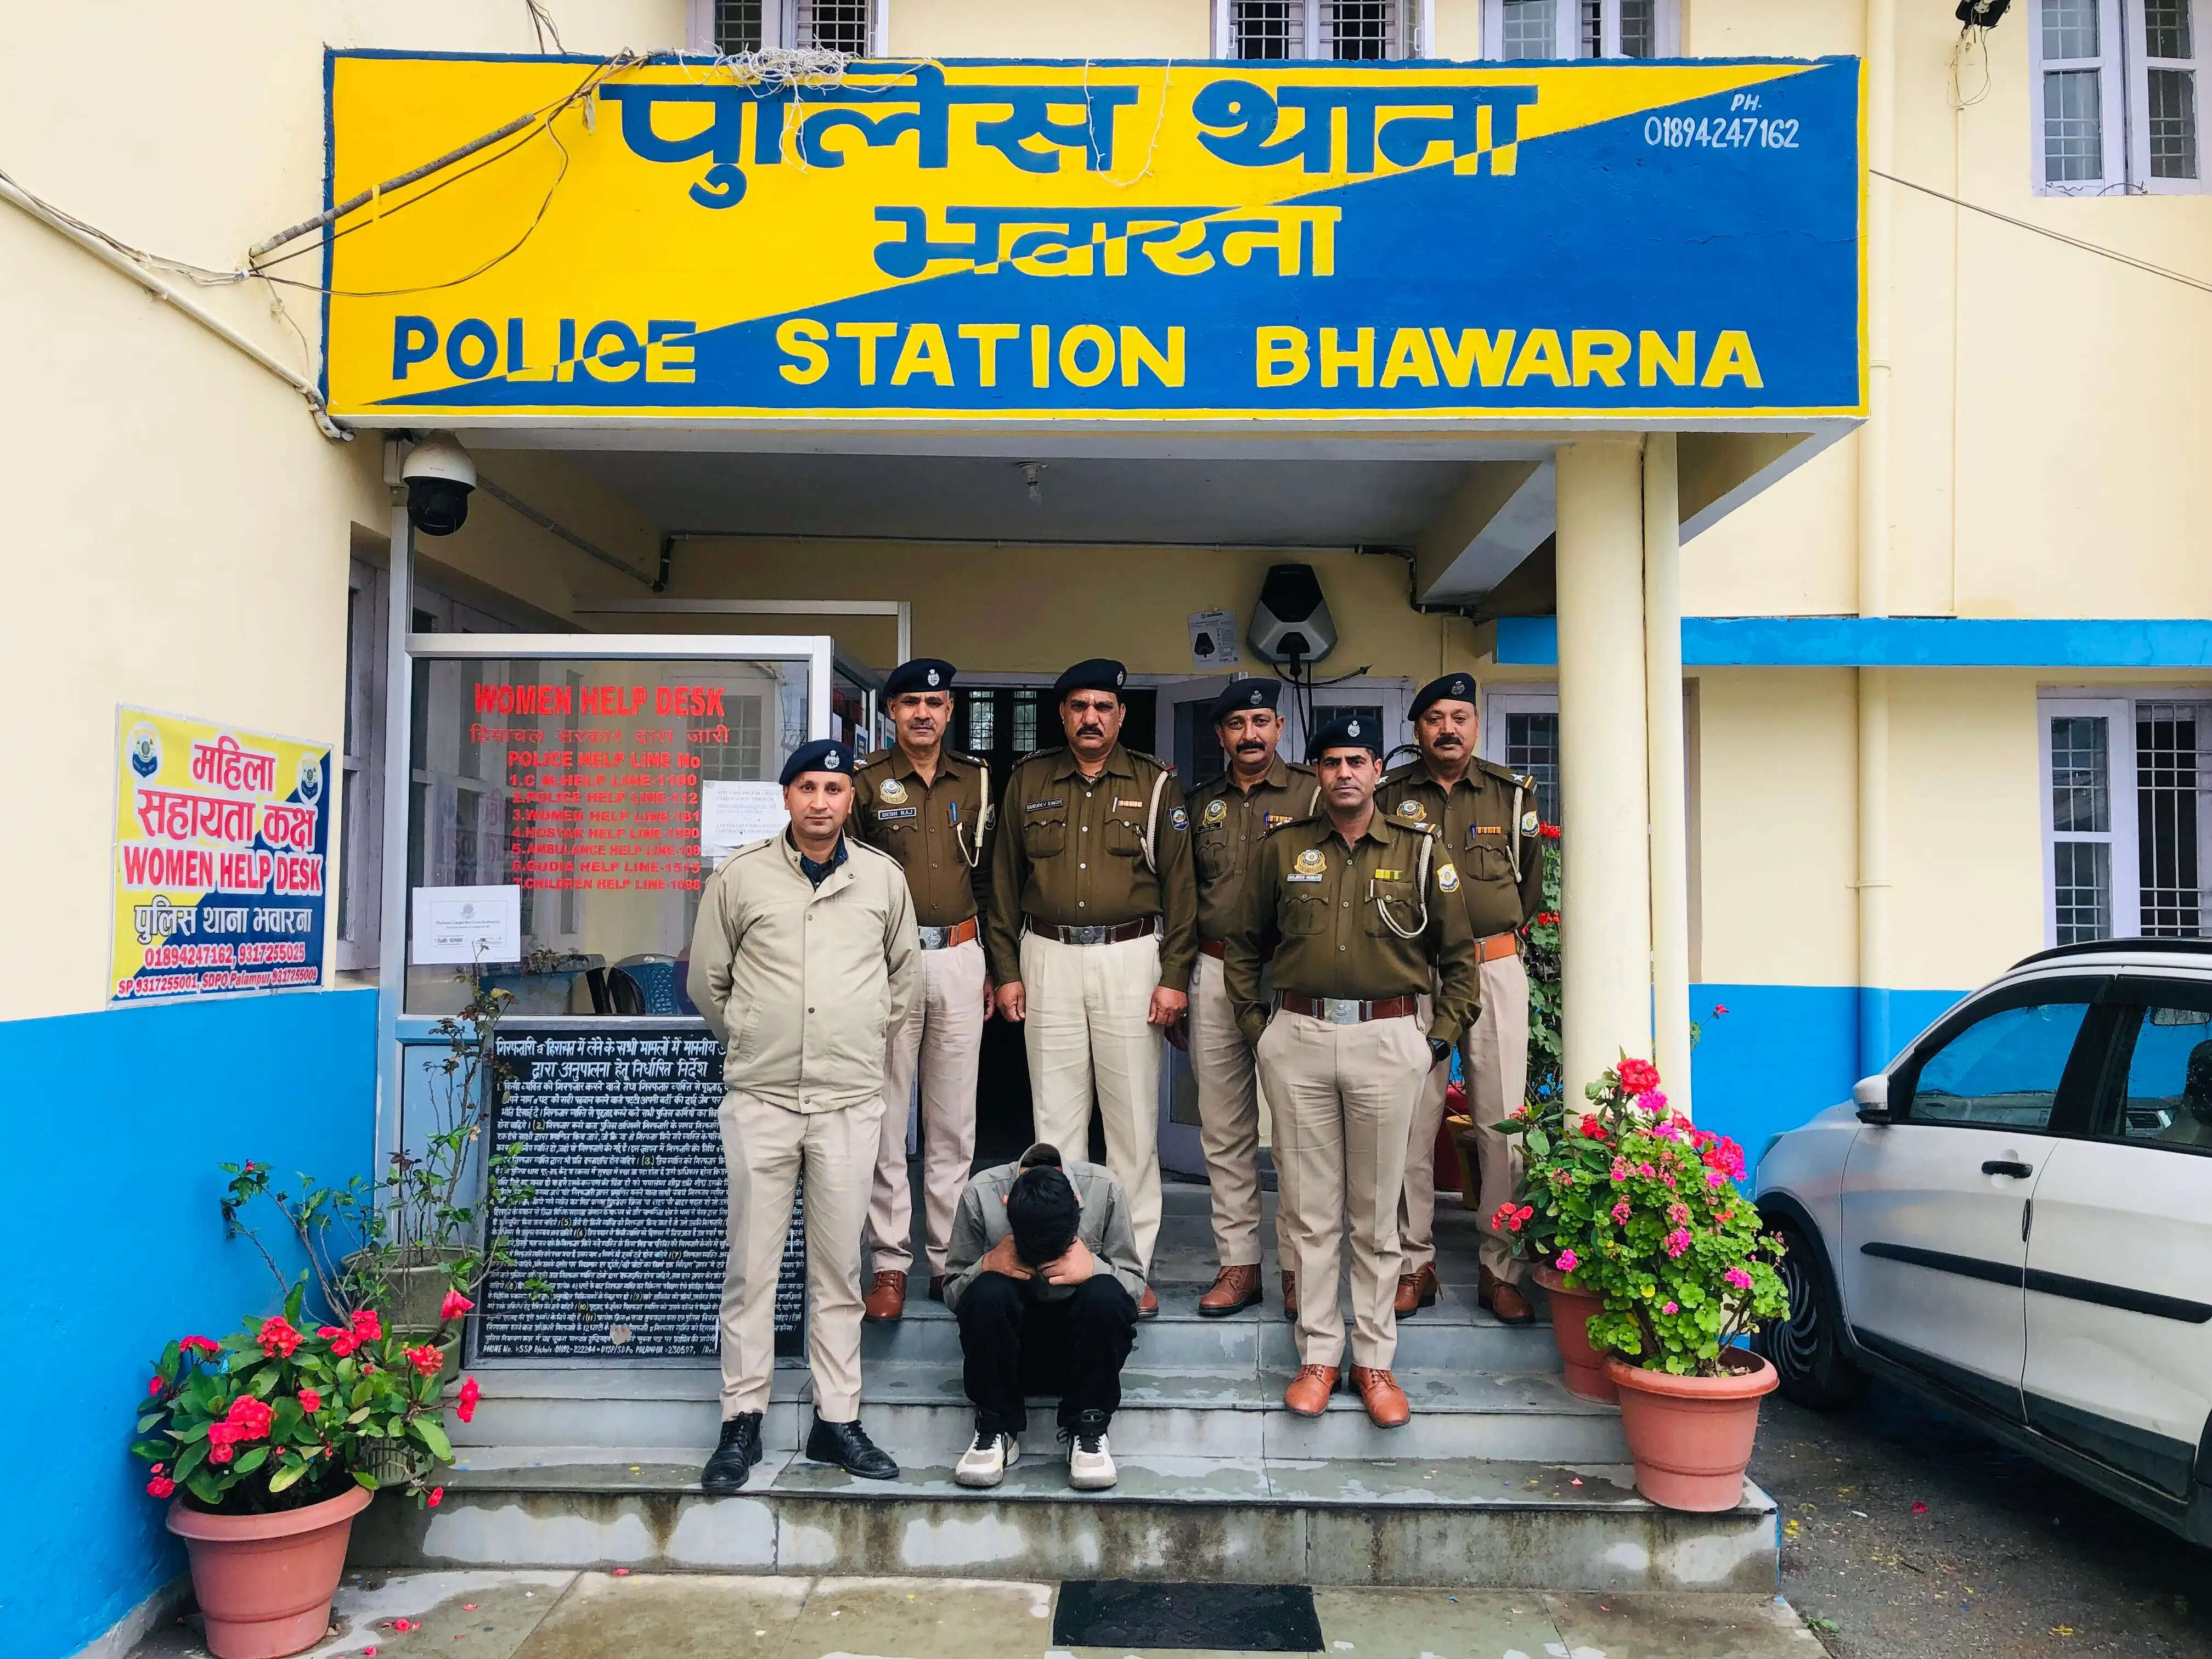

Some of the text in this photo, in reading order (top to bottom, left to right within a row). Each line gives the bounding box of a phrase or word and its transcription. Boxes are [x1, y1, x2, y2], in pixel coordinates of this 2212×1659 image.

[1730, 94, 1762, 111] PH.
[599, 59, 1538, 209] पुलिस थाना
[1644, 116, 1799, 148] 01894247162
[874, 206, 1342, 278] भवारना
[393, 315, 1764, 388] POLICE STATION BHAWARNA
[475, 683, 725, 716] WOMEN HELP DESK
[470, 723, 729, 745] हिमाचल सरकार द्वारा जारी
[193, 736, 275, 792] महिला
[508, 751, 701, 768] POLICE HELP LINE No
[612, 774, 698, 786] LINE-1100
[512, 792, 698, 804] 2.POLICE HELP LINE-112
[138, 789, 314, 849] सहायता कक्ष
[512, 809, 699, 822] 3.WOMEN HELP LINE-181
[588, 827, 625, 839] HELP
[511, 843, 606, 856] 5.AMBULANCE
[610, 844, 641, 856] HELP
[125, 847, 320, 890] WOMEN HELP DESK
[580, 861, 619, 872] HELP
[597, 878, 630, 890] HELP
[134, 895, 312, 945] पुलिस थाना भवारना
[239, 944, 304, 962] 9317255025
[119, 980, 133, 994] SP
[202, 973, 228, 988] SDPO
[577, 1037, 586, 1056] में
[587, 1036, 604, 1056] लेने
[604, 1037, 616, 1056] के
[616, 1037, 640, 1056] सभी
[640, 1036, 671, 1056] मामलों
[672, 1036, 682, 1056] में
[683, 1037, 719, 1056] माननीय
[531, 1062, 558, 1079] द्वारा
[558, 1062, 612, 1081] अनुपालना
[631, 1057, 674, 1077] निर्धारित
[676, 1058, 709, 1079] निर्देश
